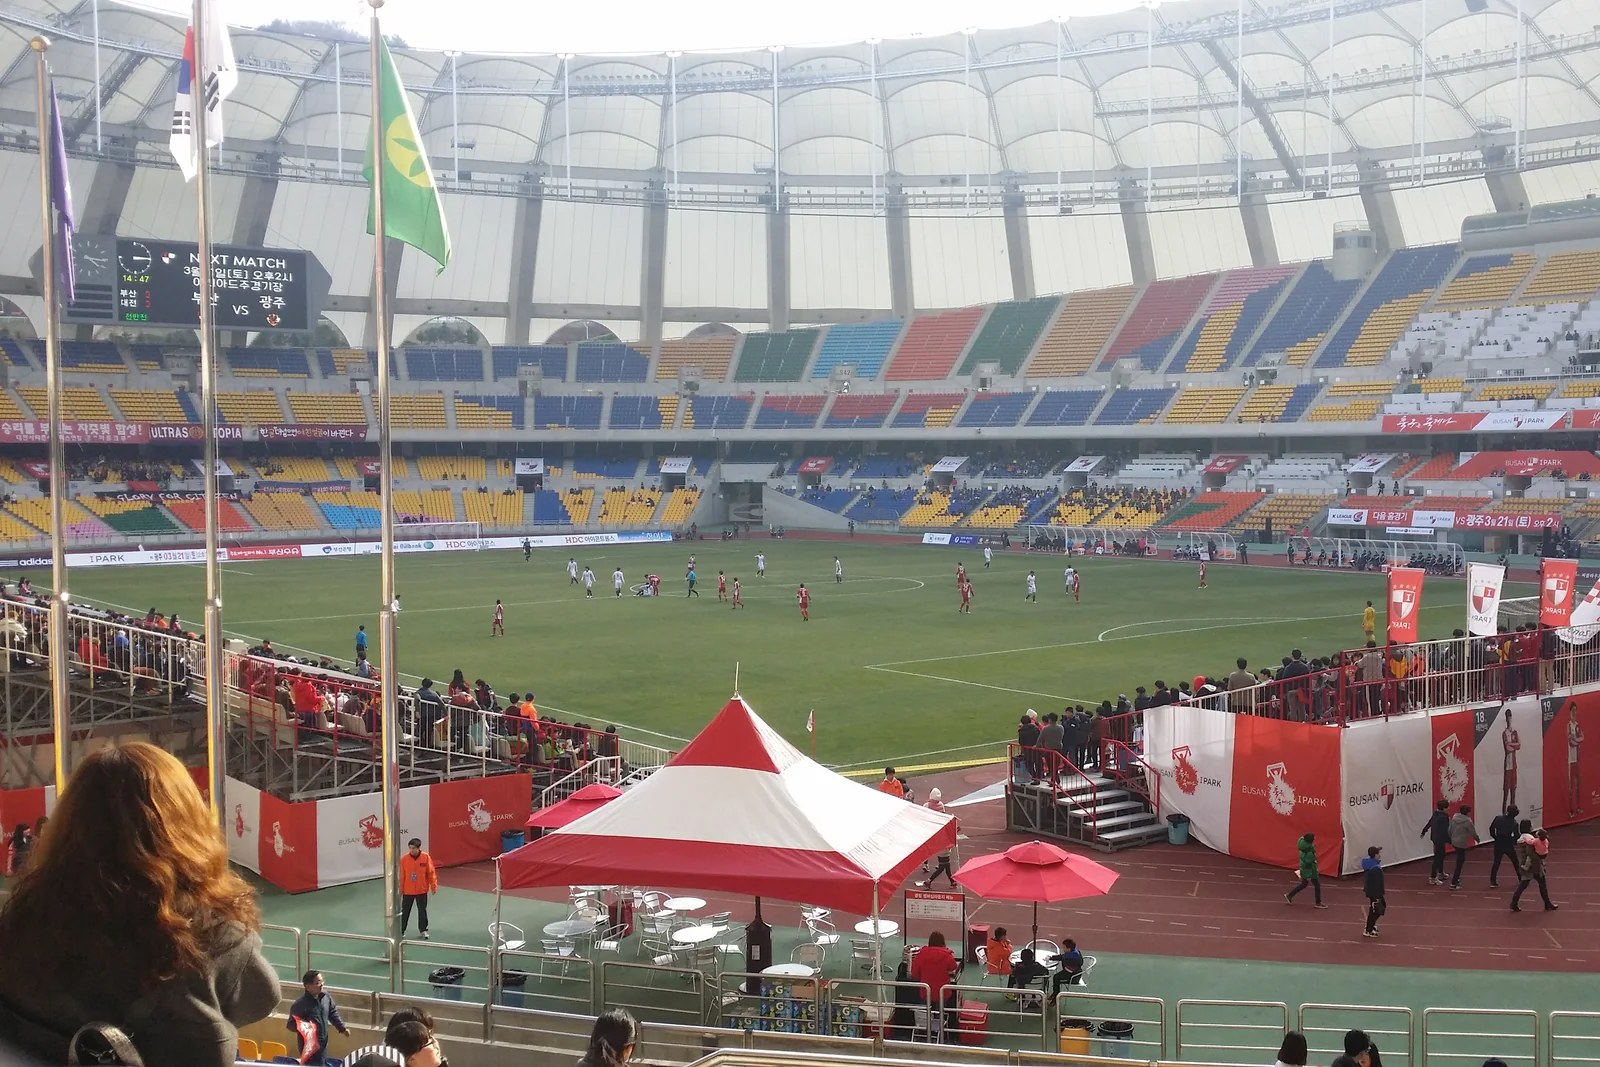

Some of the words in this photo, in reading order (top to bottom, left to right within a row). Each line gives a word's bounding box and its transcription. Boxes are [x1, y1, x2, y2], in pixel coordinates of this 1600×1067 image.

[190, 253, 228, 265] NXT
[234, 256, 286, 268] MATCH
[252, 270, 292, 282] 오후2시
[120, 289, 136, 298] 부산
[120, 298, 136, 307] 대전
[260, 295, 286, 308] 광주
[232, 305, 249, 315] VS
[151, 427, 188, 438] ULTRAS
[1388, 512, 1408, 521] 홈경기
[1456, 516, 1465, 525] VS
[1466, 515, 1484, 526] 광주
[1516, 516, 1531, 528] (토)
[20, 558, 54, 566] adidas
[1200, 776, 1222, 788] IPARK
[1242, 785, 1267, 797] BUSAN
[1298, 795, 1327, 807] IPARK
[1350, 792, 1380, 807] BUSAN
[1396, 782, 1424, 796] IPARK
[338, 836, 360, 845] BUSAN
[776, 985, 783, 994] G
[776, 1002, 784, 1011] G
[808, 1004, 816, 1012] G
[842, 1006, 850, 1016] G
